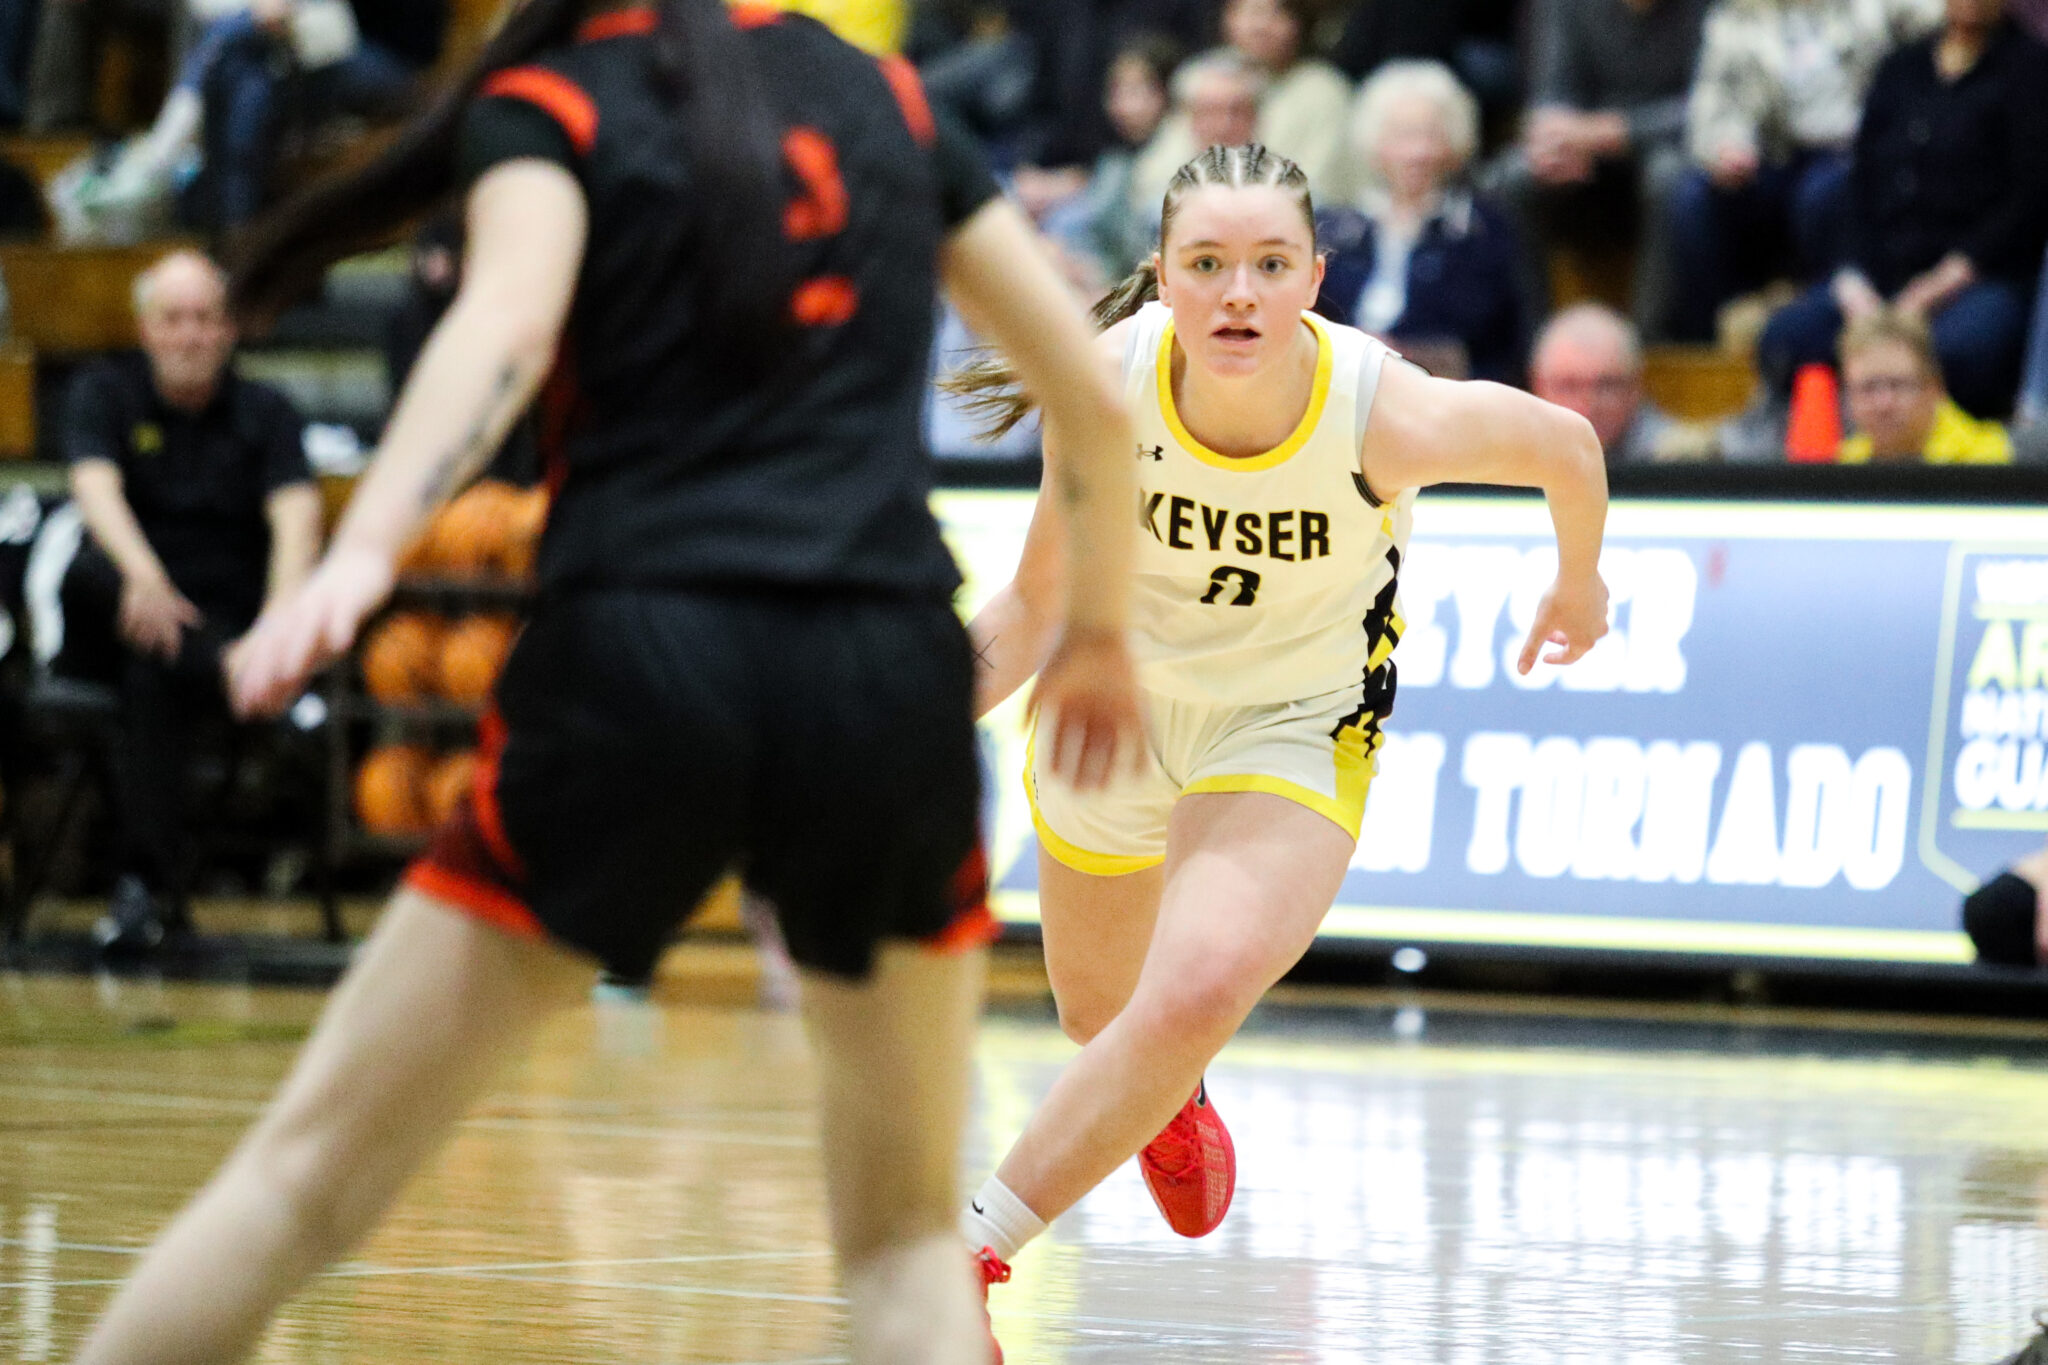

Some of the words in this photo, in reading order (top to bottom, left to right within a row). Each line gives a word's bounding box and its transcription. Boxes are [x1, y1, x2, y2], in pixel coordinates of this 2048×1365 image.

[1139, 488, 1331, 562] KEYSER
[1397, 541, 1698, 692] EYSER
[1461, 732, 1912, 891] TORNADO
